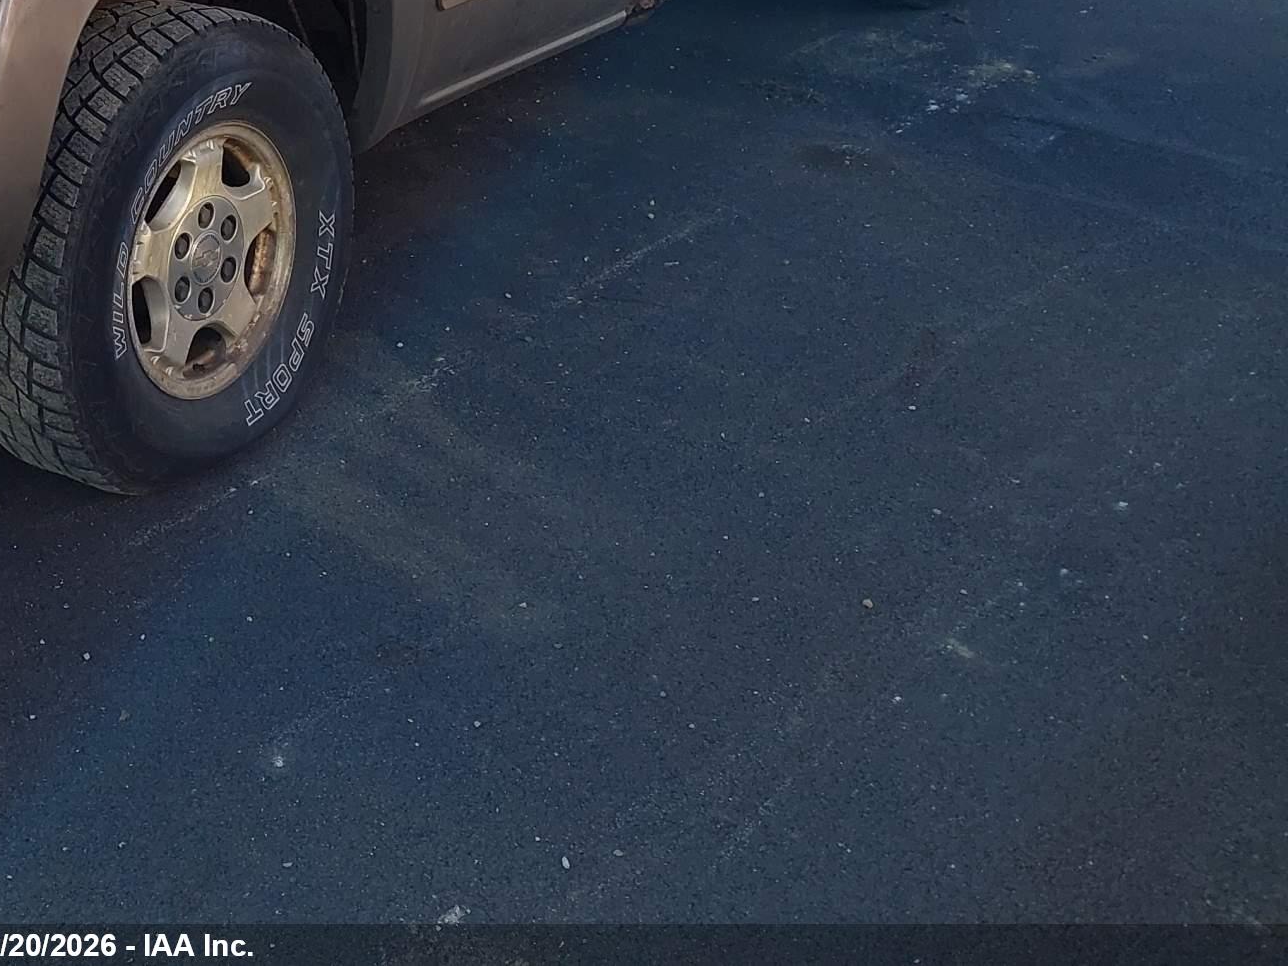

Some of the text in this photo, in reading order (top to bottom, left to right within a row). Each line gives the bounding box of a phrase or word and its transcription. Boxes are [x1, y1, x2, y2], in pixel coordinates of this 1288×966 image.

[115, 81, 253, 360] WILD COUNTRY
[243, 209, 336, 427] XTX SPORT
